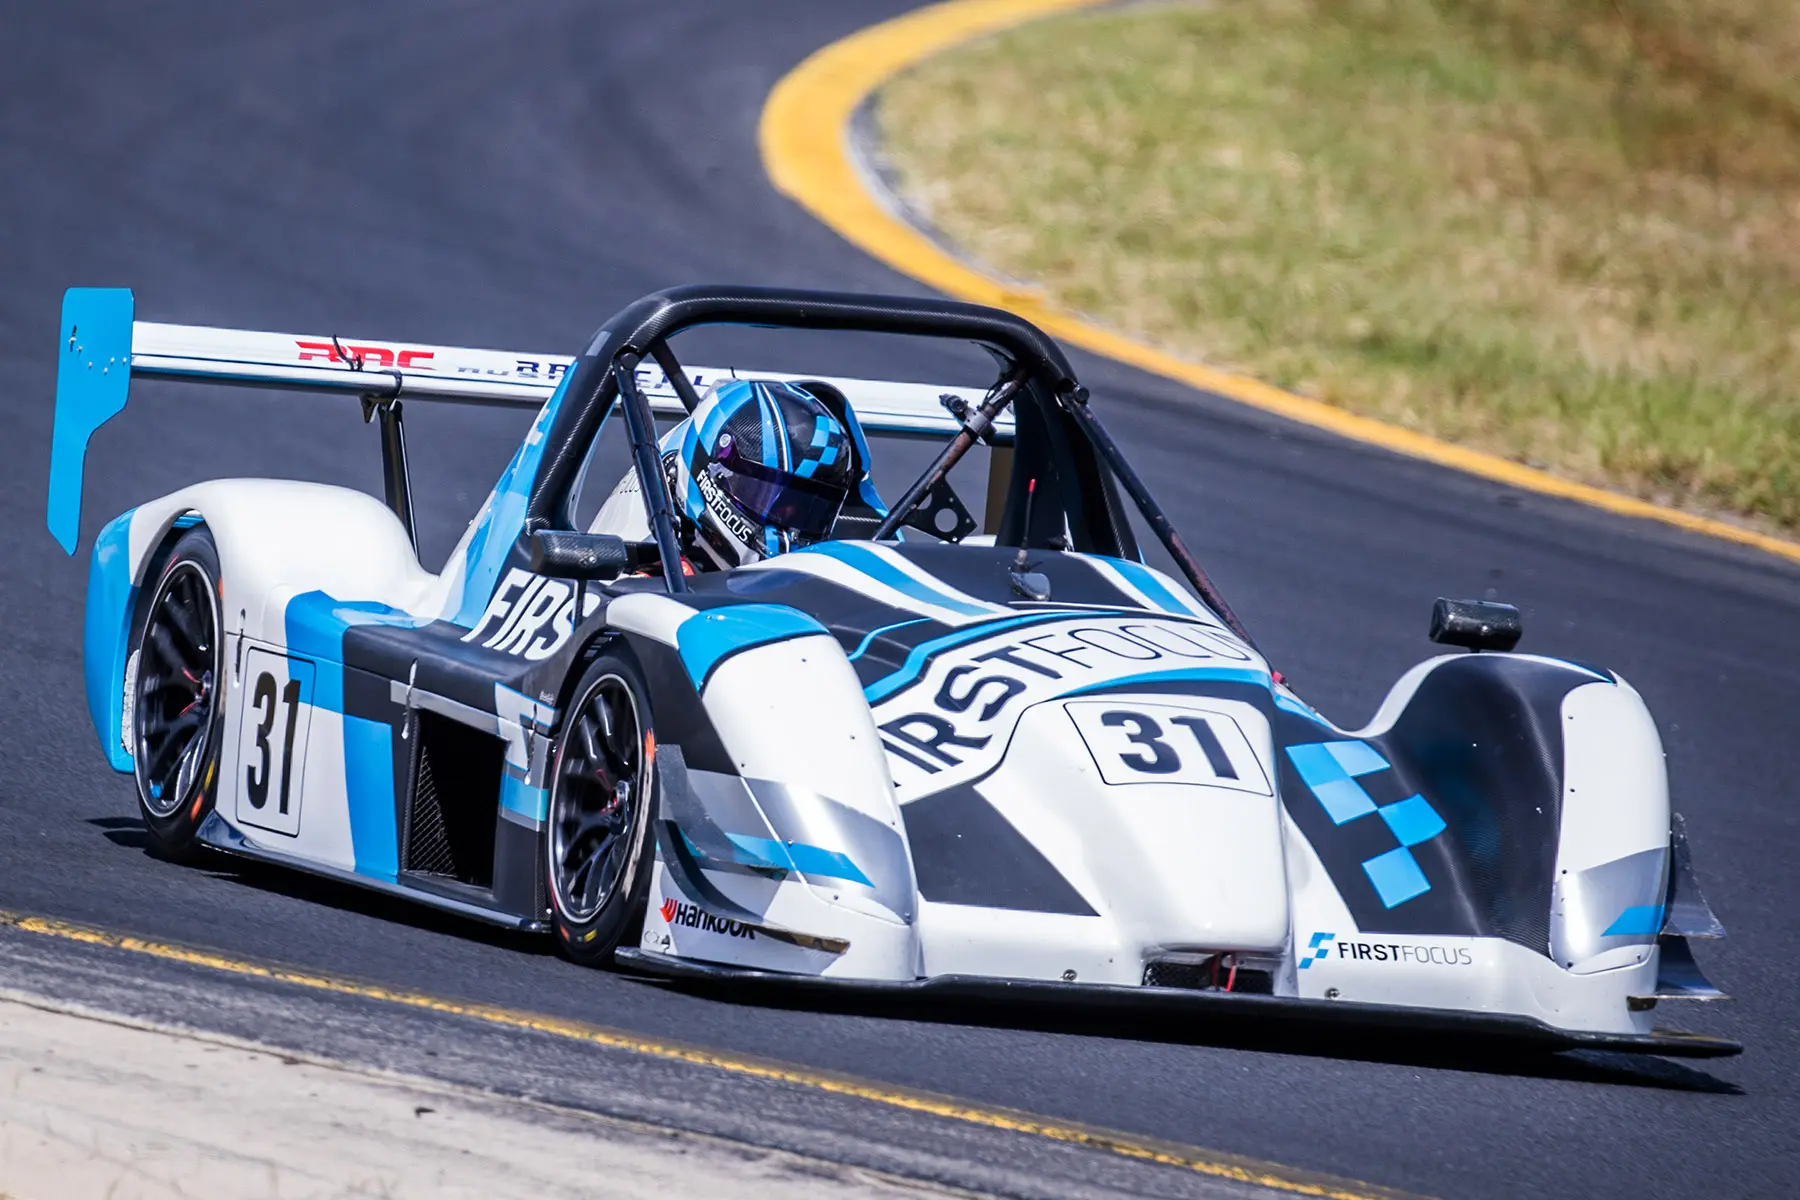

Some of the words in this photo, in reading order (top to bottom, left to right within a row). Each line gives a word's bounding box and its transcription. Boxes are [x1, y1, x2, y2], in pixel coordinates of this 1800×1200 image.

[696, 469, 752, 542] FIRSTFOCUS
[246, 671, 302, 816] 31
[1101, 711, 1239, 780] 31
[1337, 942, 1473, 965] FIRSTFOCUS
